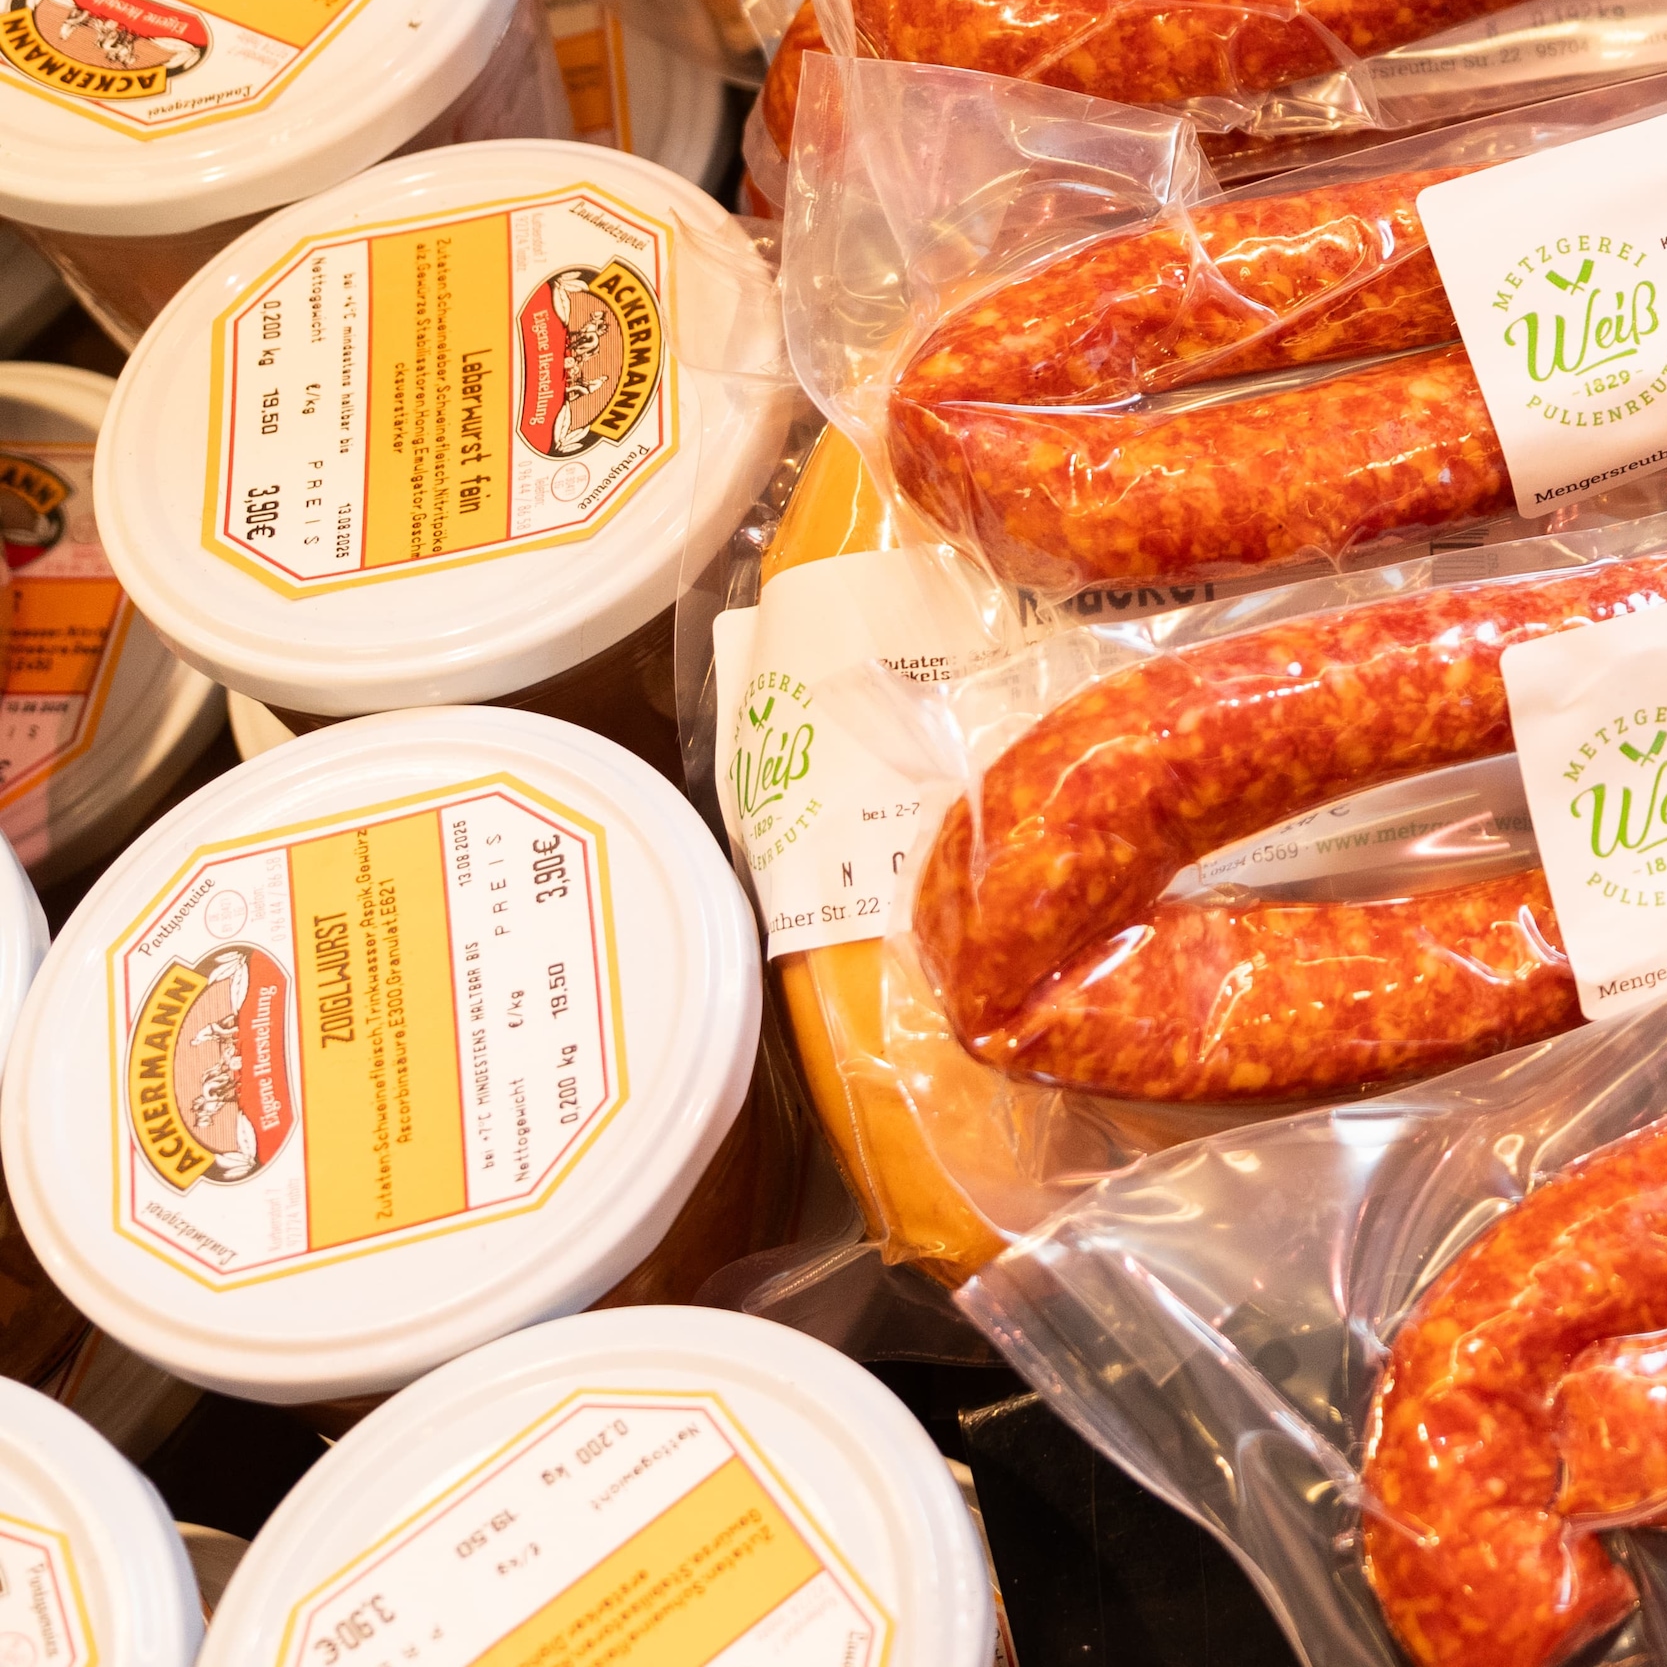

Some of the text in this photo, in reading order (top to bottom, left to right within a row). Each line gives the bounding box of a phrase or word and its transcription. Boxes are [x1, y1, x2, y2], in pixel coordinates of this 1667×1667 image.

[3, 15, 160, 93] ACKERMANN
[1492, 234, 1647, 311] METZGEREI
[530, 309, 554, 427] Eigene Herstellung
[599, 275, 652, 432] ACKERMANN
[1503, 279, 1660, 383] Weiß
[260, 388, 279, 435] 19.50
[1584, 368, 1631, 397] 1829
[458, 348, 492, 515] Leberwurst fein
[334, 502, 351, 559] 13.08.2025
[451, 819, 472, 887] 13.08.2025
[132, 877, 225, 957] Partyservice
[312, 911, 356, 1049] ZOIGLWURST
[139, 976, 204, 1175] ACKERMANN
[251, 985, 281, 1130] Eigene Herstellung
[556, 1075, 579, 1124] 0,200
